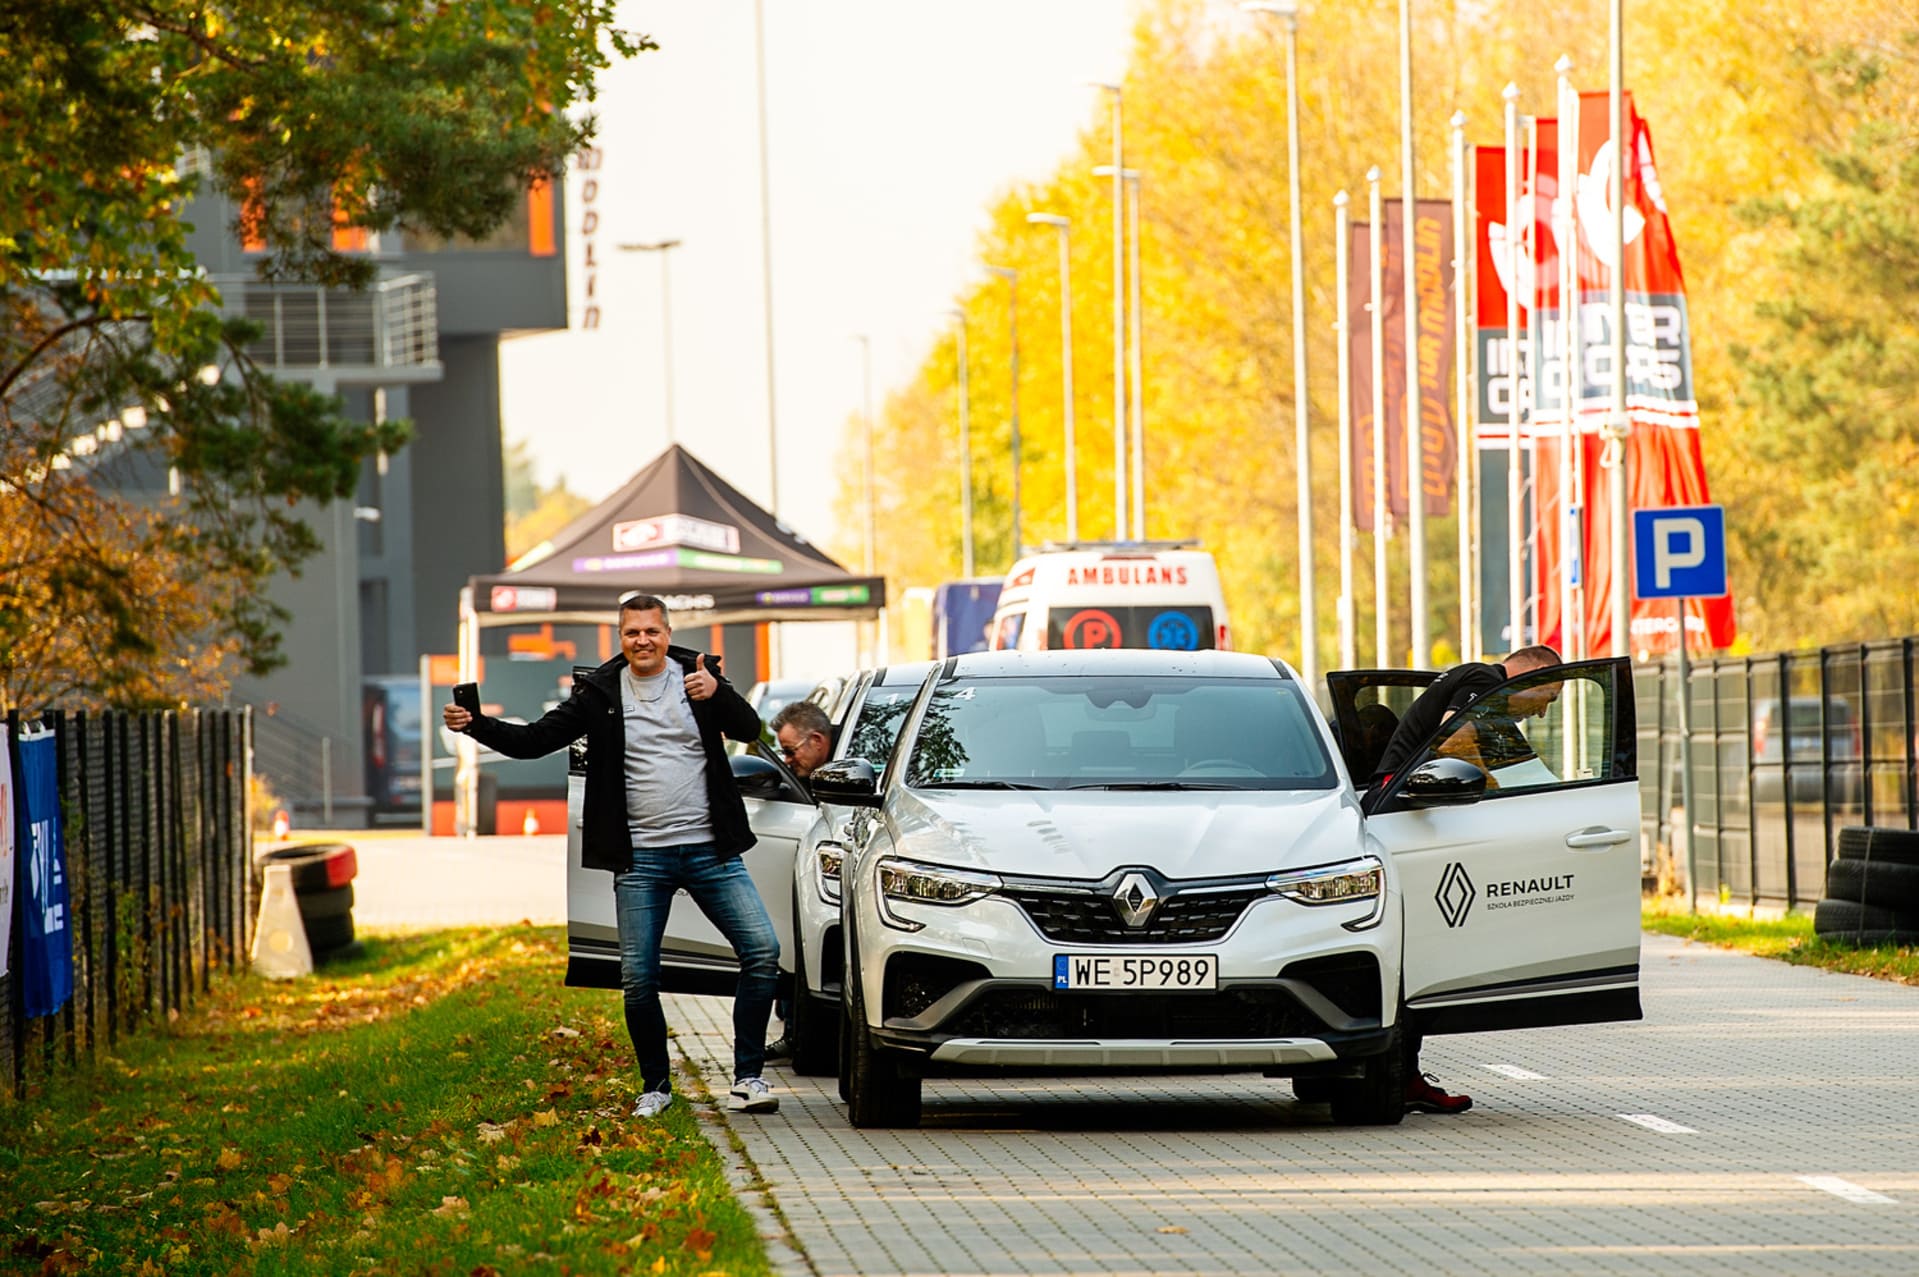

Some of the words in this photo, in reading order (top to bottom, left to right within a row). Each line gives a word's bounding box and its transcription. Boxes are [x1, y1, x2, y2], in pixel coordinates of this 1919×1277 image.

[1653, 517, 1706, 589] P
[1067, 567, 1188, 585] AMBULANS
[1487, 874, 1575, 898] RENAULT
[1057, 976, 1068, 984] PL
[1075, 959, 1110, 985] WE
[1123, 959, 1210, 986] 5P989
